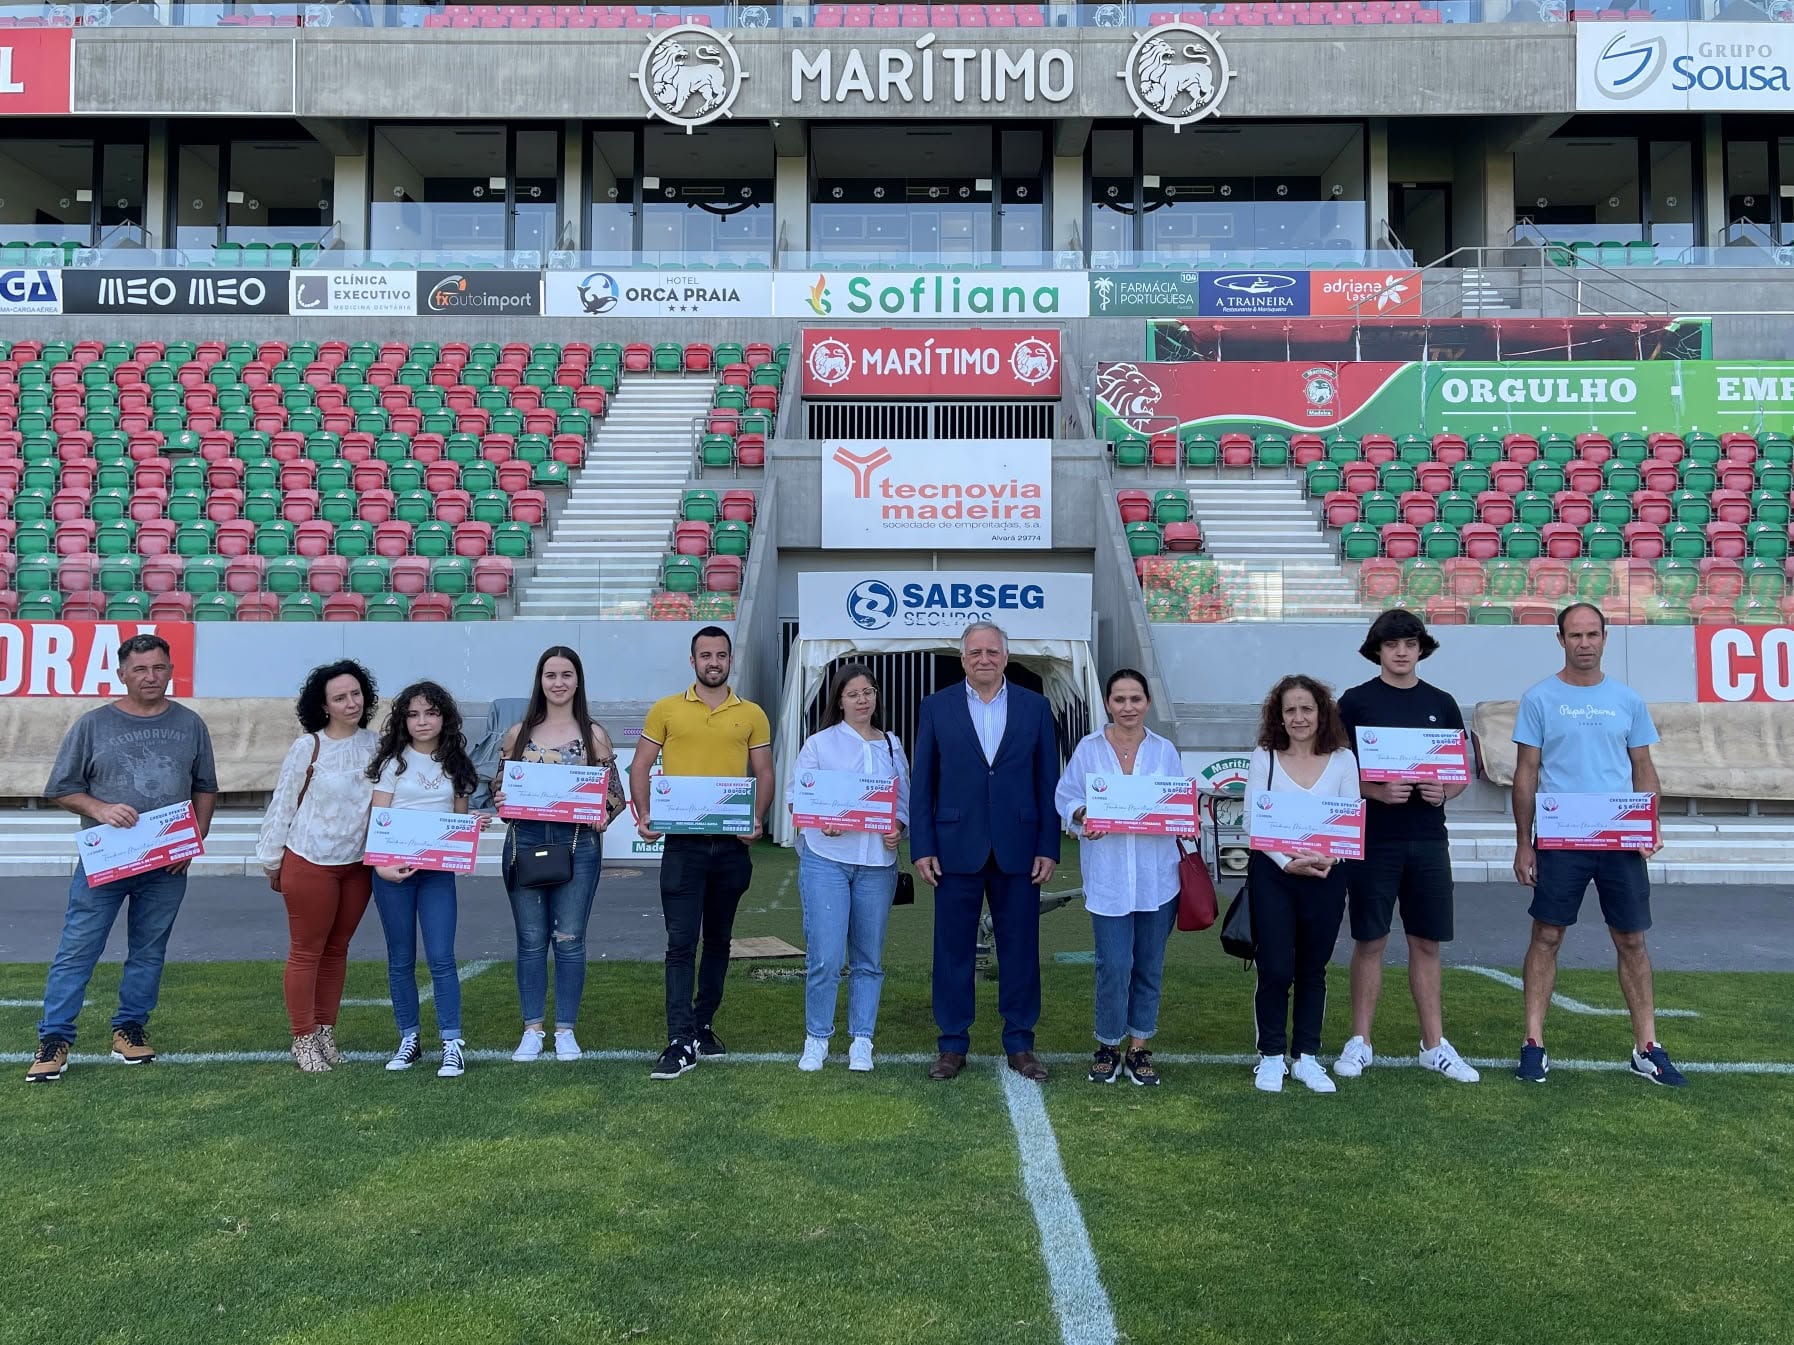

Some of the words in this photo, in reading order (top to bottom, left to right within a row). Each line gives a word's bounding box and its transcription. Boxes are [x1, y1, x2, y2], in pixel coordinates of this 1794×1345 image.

[1699, 42, 1773, 58] GRUPO
[791, 32, 1075, 102] MARÍTIMO
[1672, 55, 1791, 91] Sousa
[334, 274, 387, 285] CLÍNICA
[667, 276, 699, 285] HOTEL
[1182, 274, 1196, 282] 104
[1323, 278, 1382, 293] adriana
[98, 277, 176, 305] MEO
[188, 277, 266, 305] MEO
[1121, 281, 1178, 293] FARMÁCIA
[334, 290, 410, 300] EXECUTIVO
[625, 288, 678, 302] ORCA
[685, 288, 741, 302] PRAIA
[847, 276, 1059, 314] Sofliana
[1121, 294, 1194, 304] PORTUGUESA
[1216, 298, 1224, 306] A
[1227, 297, 1294, 306] TRAINEIRA
[862, 338, 1000, 375] MARÍTIMO
[1442, 378, 1637, 403] ORGULHO
[879, 477, 1041, 499] tecnovia
[882, 500, 1041, 519] madeira
[902, 584, 1044, 609] SABSEG
[635, 842, 664, 852] Made
